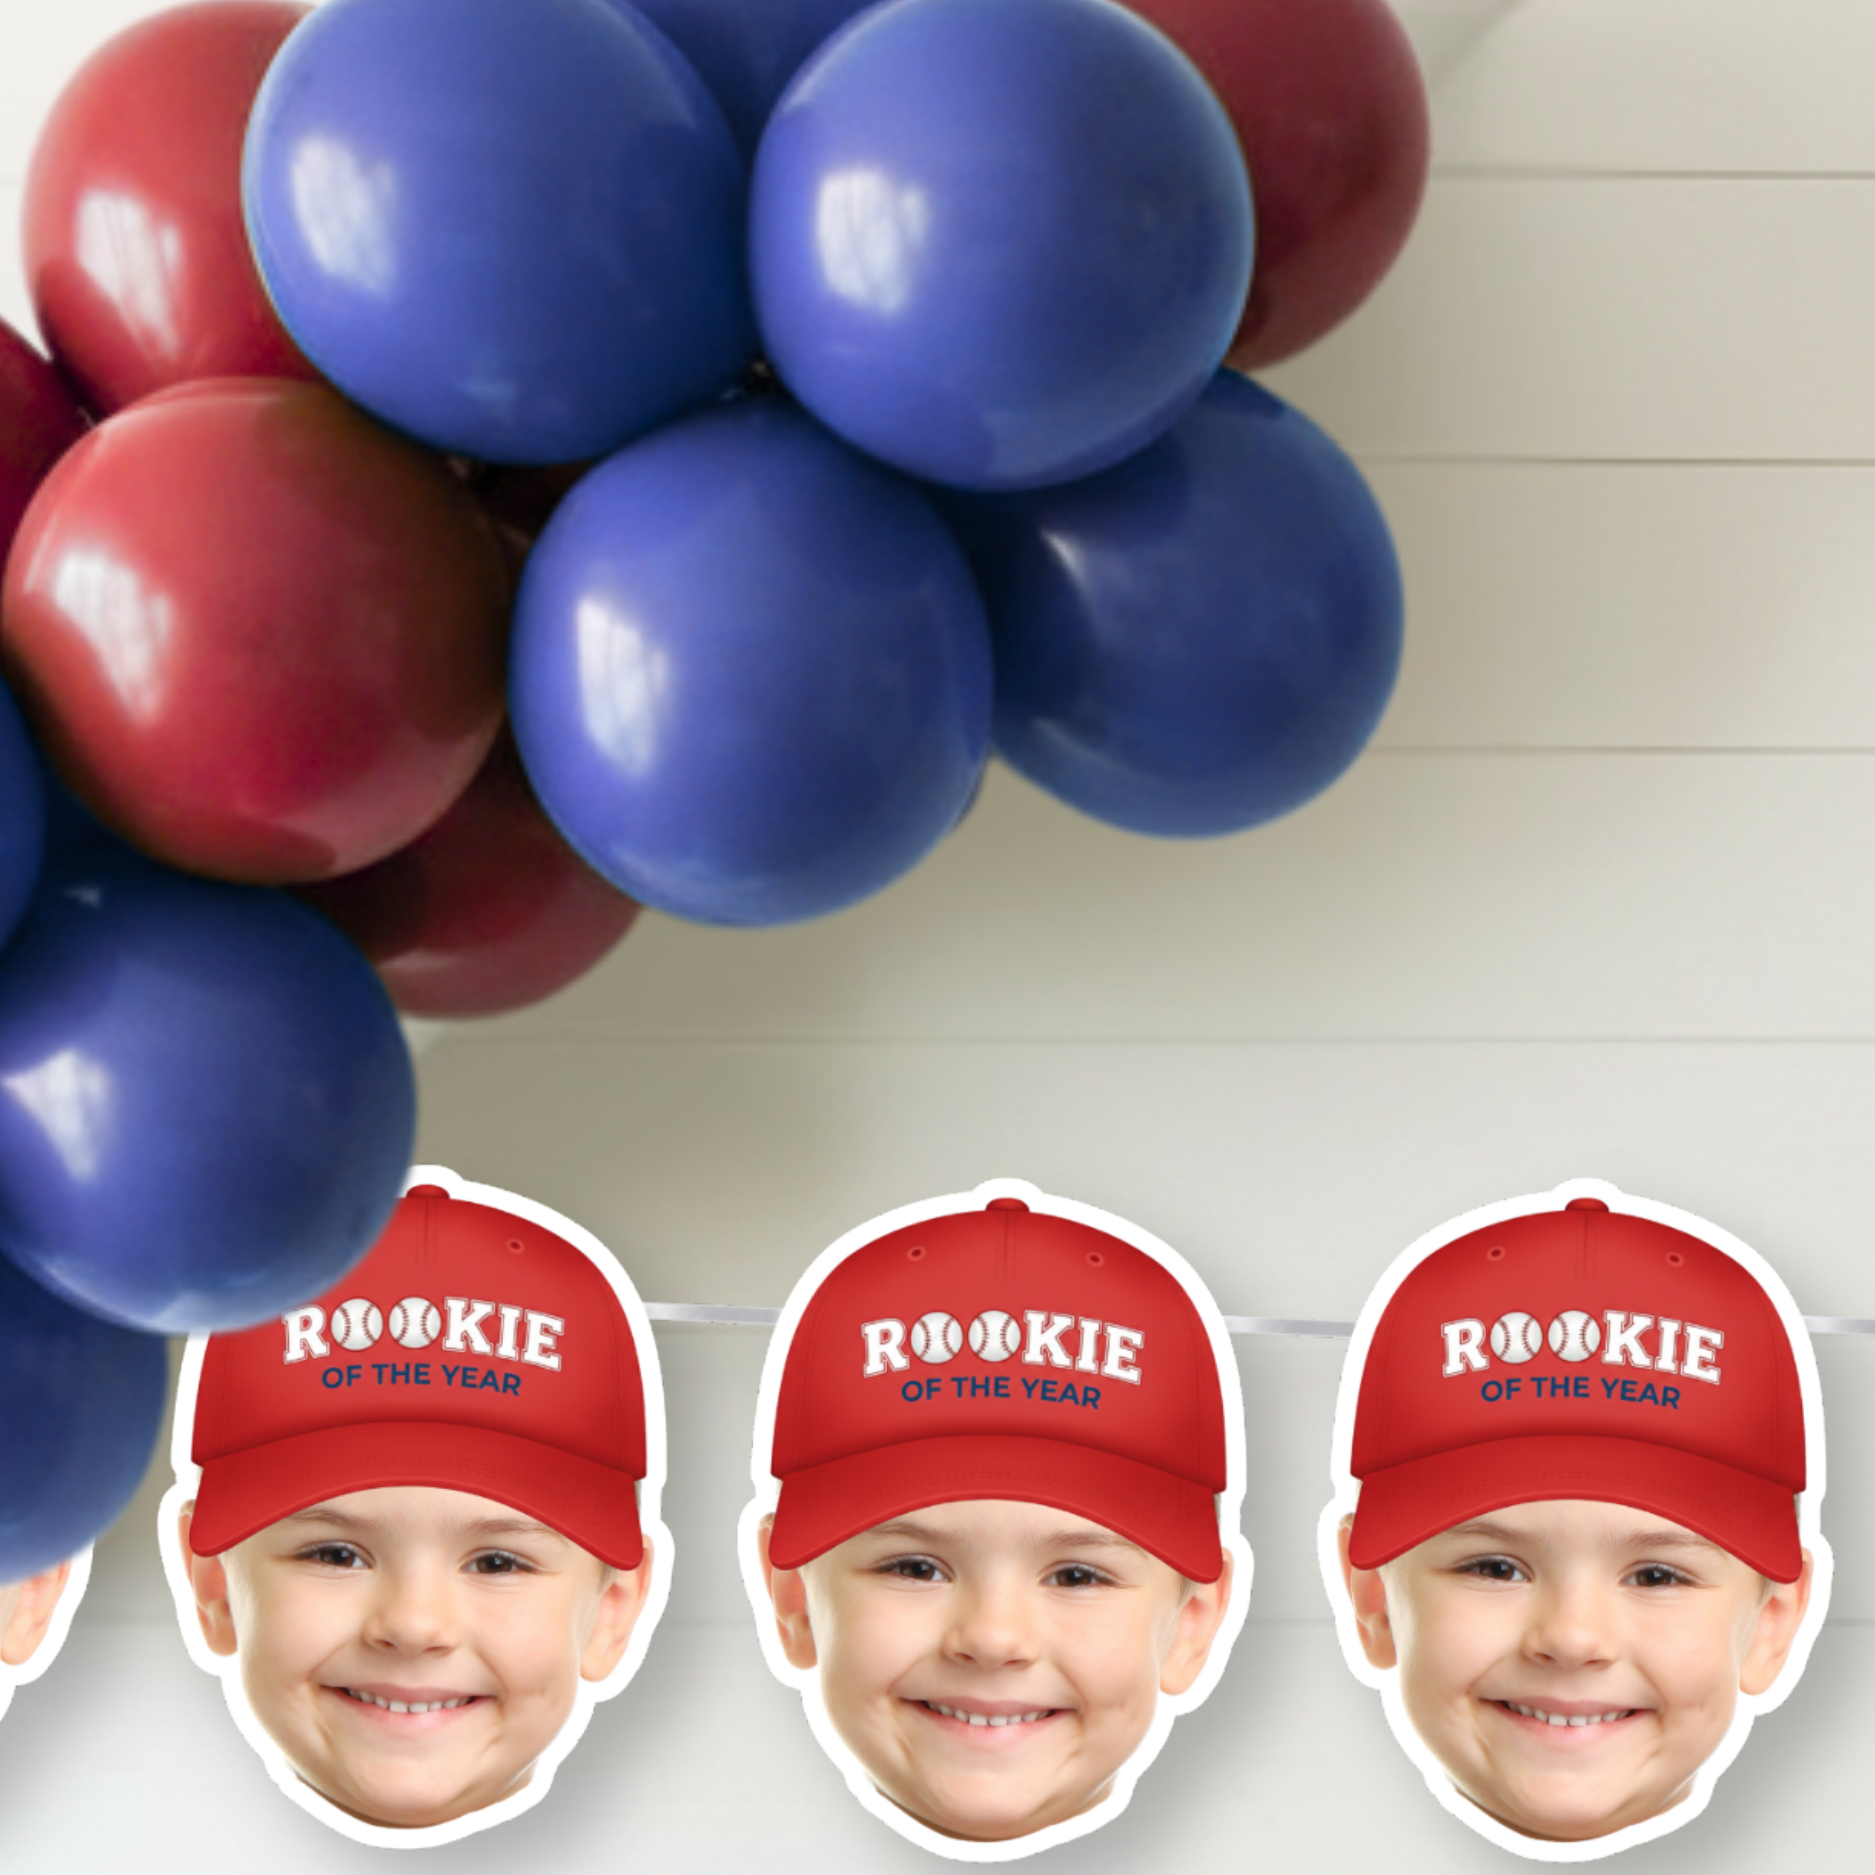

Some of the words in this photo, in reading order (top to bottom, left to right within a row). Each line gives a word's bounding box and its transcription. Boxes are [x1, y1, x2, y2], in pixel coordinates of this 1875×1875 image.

[282, 1297, 565, 1372] ROOKIE
[861, 1309, 1145, 1386] ROOKIE
[1441, 1309, 1725, 1386] ROOKIE
[321, 1364, 362, 1389] OF
[371, 1363, 431, 1385] THE
[441, 1364, 522, 1396] YEAR
[901, 1378, 942, 1402] OF
[950, 1376, 1011, 1398] THE
[1021, 1377, 1101, 1410] YEAR
[1481, 1378, 1522, 1402] OF
[1530, 1376, 1591, 1398] THE
[1601, 1377, 1681, 1410] YEAR
